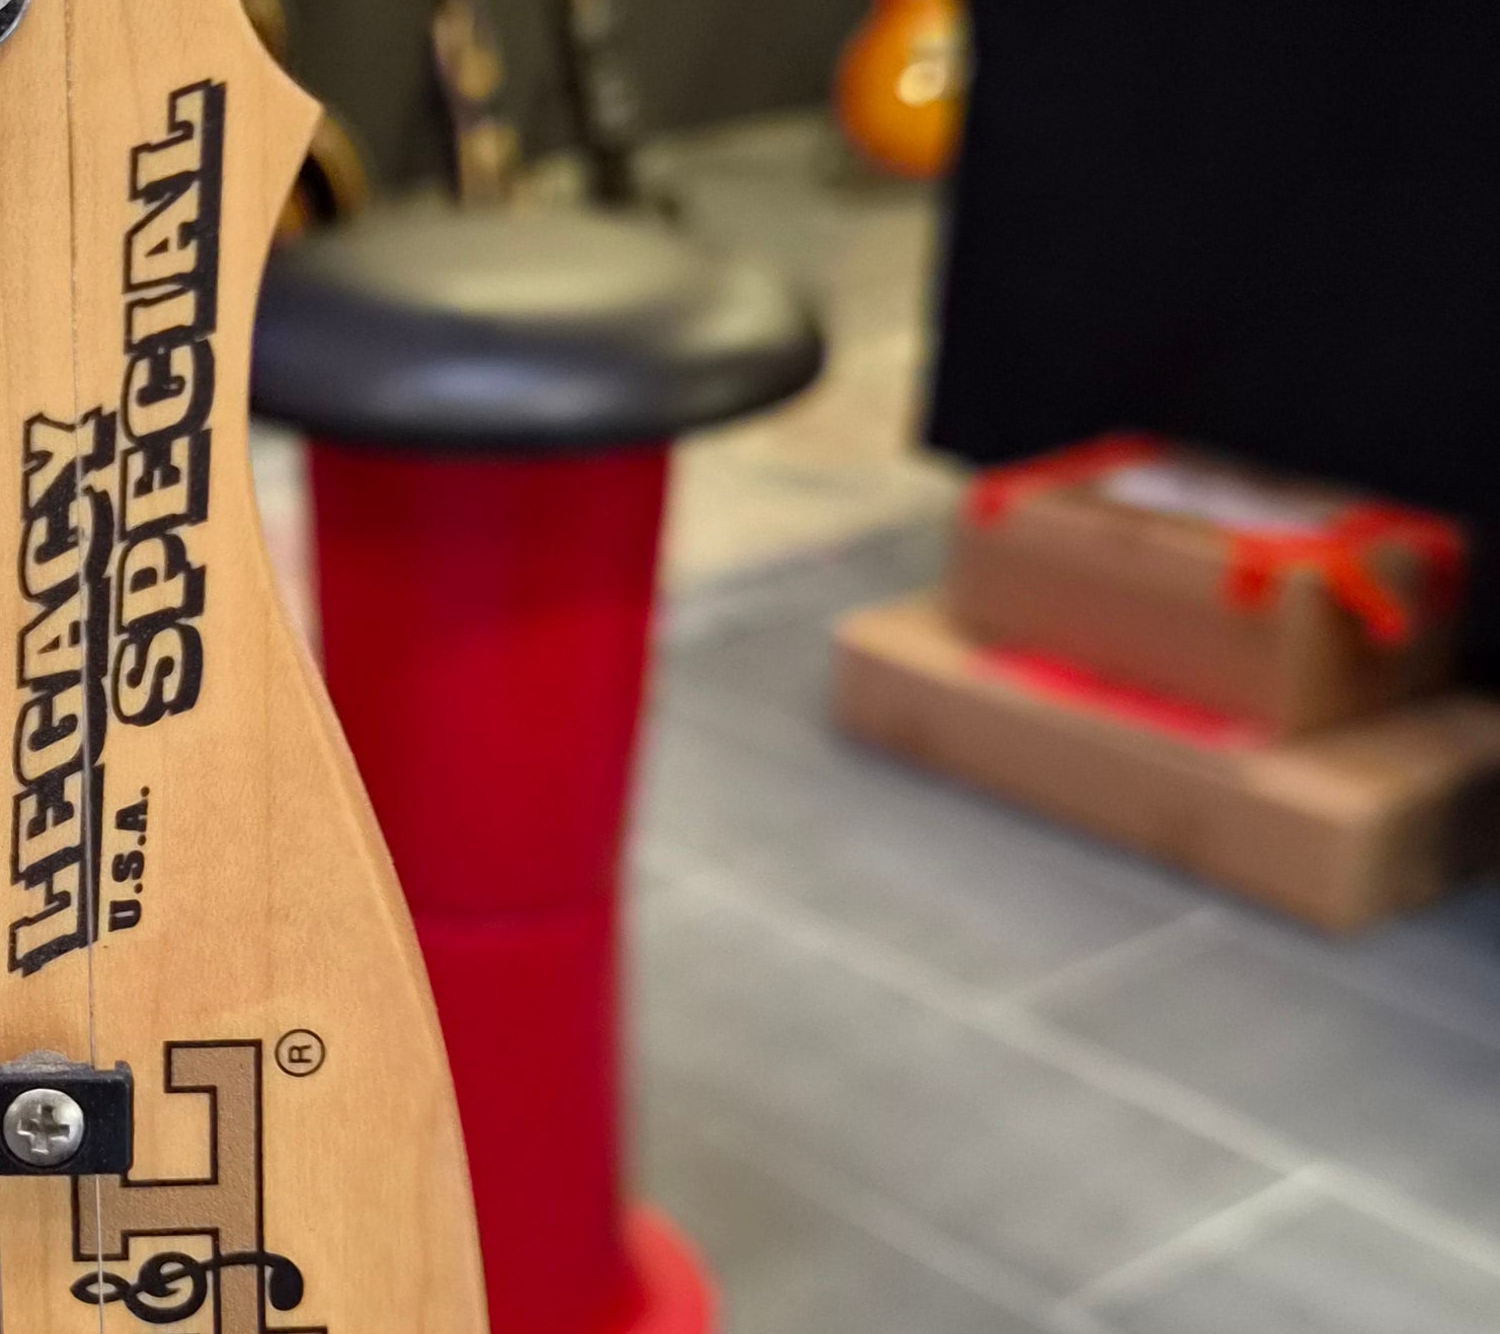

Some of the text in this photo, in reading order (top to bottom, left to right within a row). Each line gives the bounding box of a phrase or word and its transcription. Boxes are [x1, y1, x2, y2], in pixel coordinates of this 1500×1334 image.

[112, 78, 227, 727] SPECIAL
[8, 405, 117, 977] LEGACY
[108, 785, 151, 932] U.S.A.
